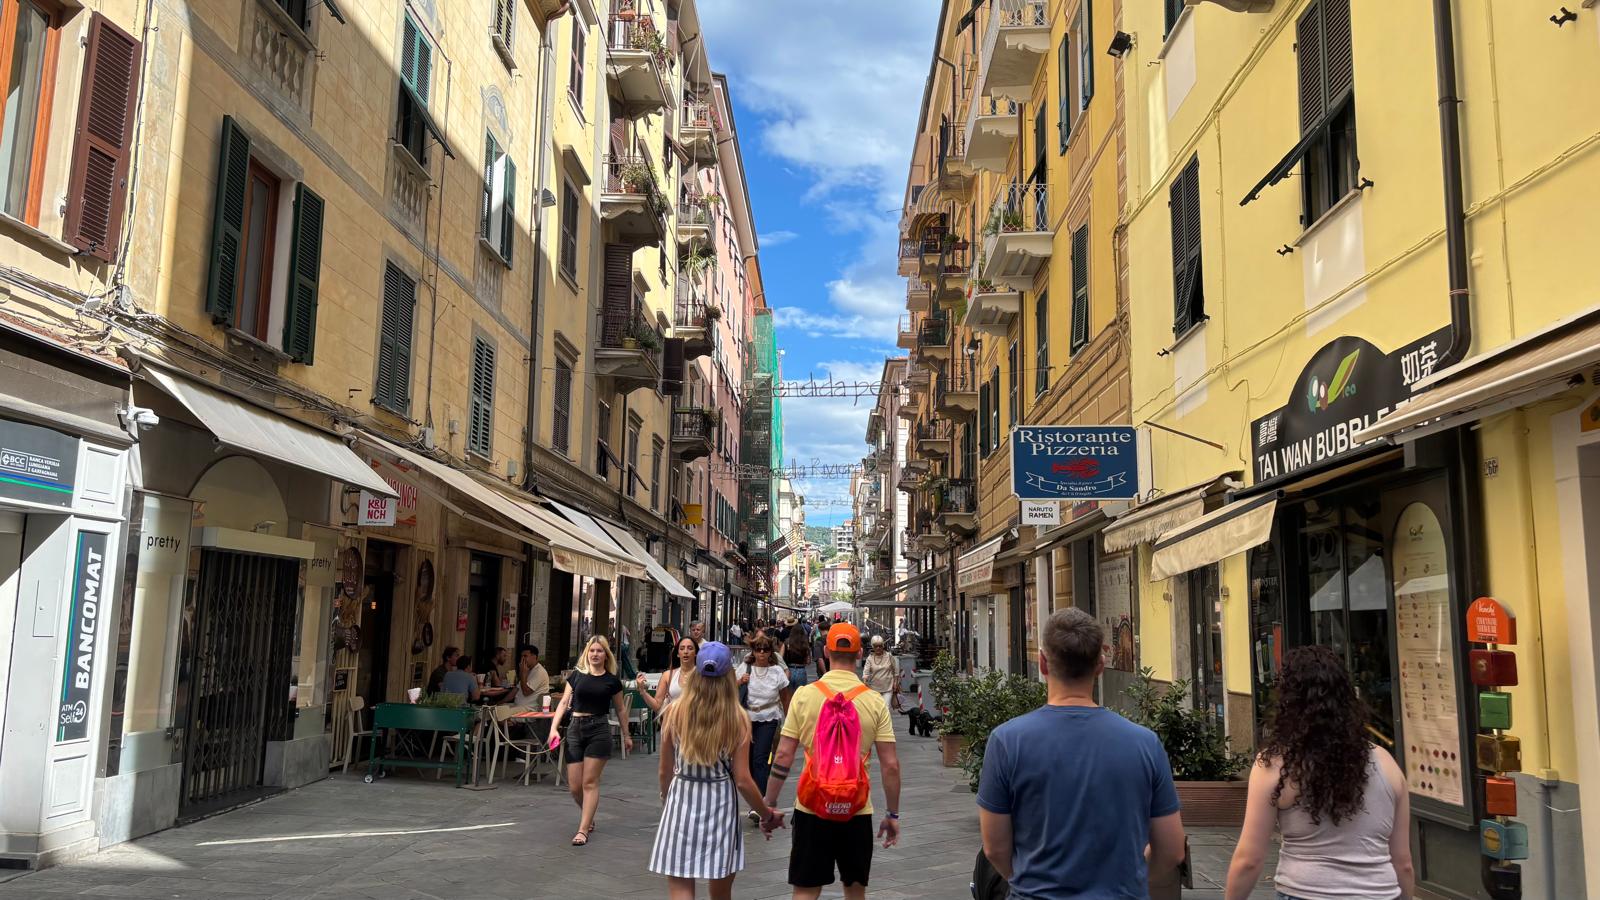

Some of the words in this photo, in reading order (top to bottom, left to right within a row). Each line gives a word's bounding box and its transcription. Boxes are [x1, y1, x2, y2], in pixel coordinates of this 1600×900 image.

[1401, 341, 1438, 386] 奶茶
[1019, 429, 1132, 443] Ristorante
[1031, 442, 1120, 456] Pizzeria
[10, 455, 26, 465] BCC
[1258, 451, 1278, 481] TAI
[1281, 437, 1312, 473] WAN
[1068, 484, 1097, 492] Sandro
[146, 535, 181, 553] pretty
[311, 557, 332, 569] pretty
[75, 547, 102, 690] BANCOMAT
[61, 704, 74, 712] ATM
[75, 707, 84, 717] 24
[60, 712, 75, 725] Self
